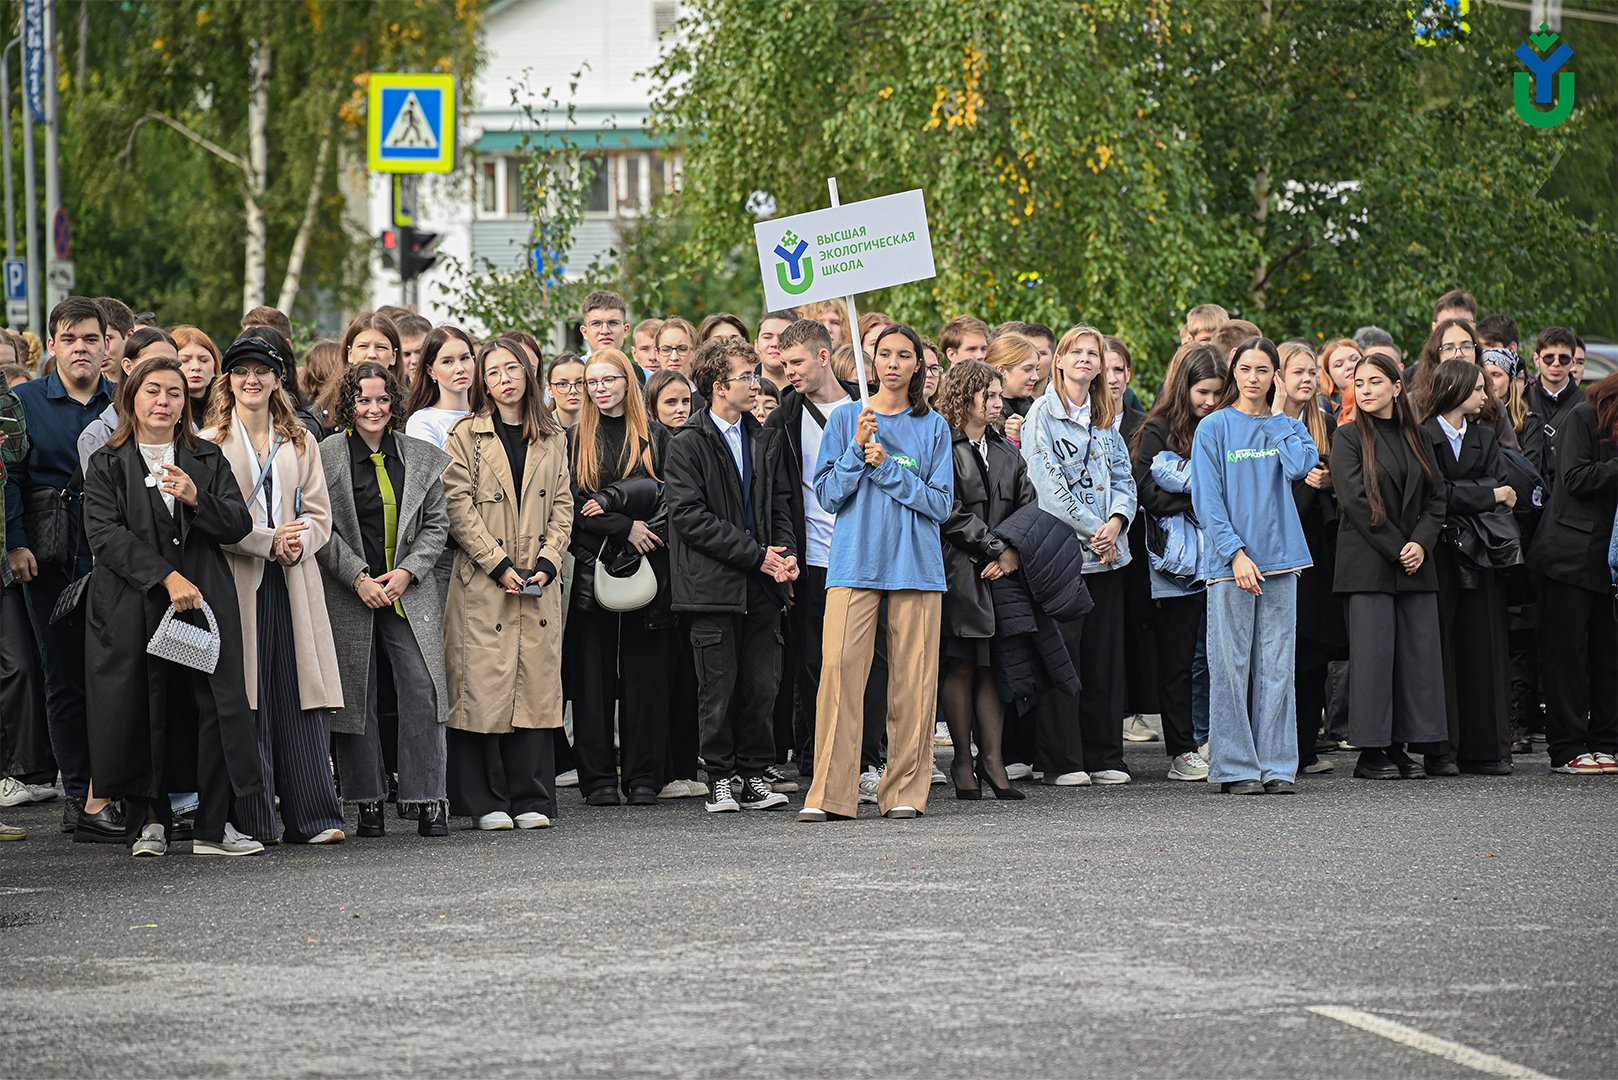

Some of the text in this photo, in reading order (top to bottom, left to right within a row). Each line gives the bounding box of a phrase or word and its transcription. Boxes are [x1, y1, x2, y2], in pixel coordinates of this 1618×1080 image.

[816, 226, 867, 246] ВЫСШАЯ
[819, 231, 916, 261] ЭКОЛОГИЧЕСКАЯ
[821, 258, 864, 276] ШКОЛА
[9, 263, 23, 297] P
